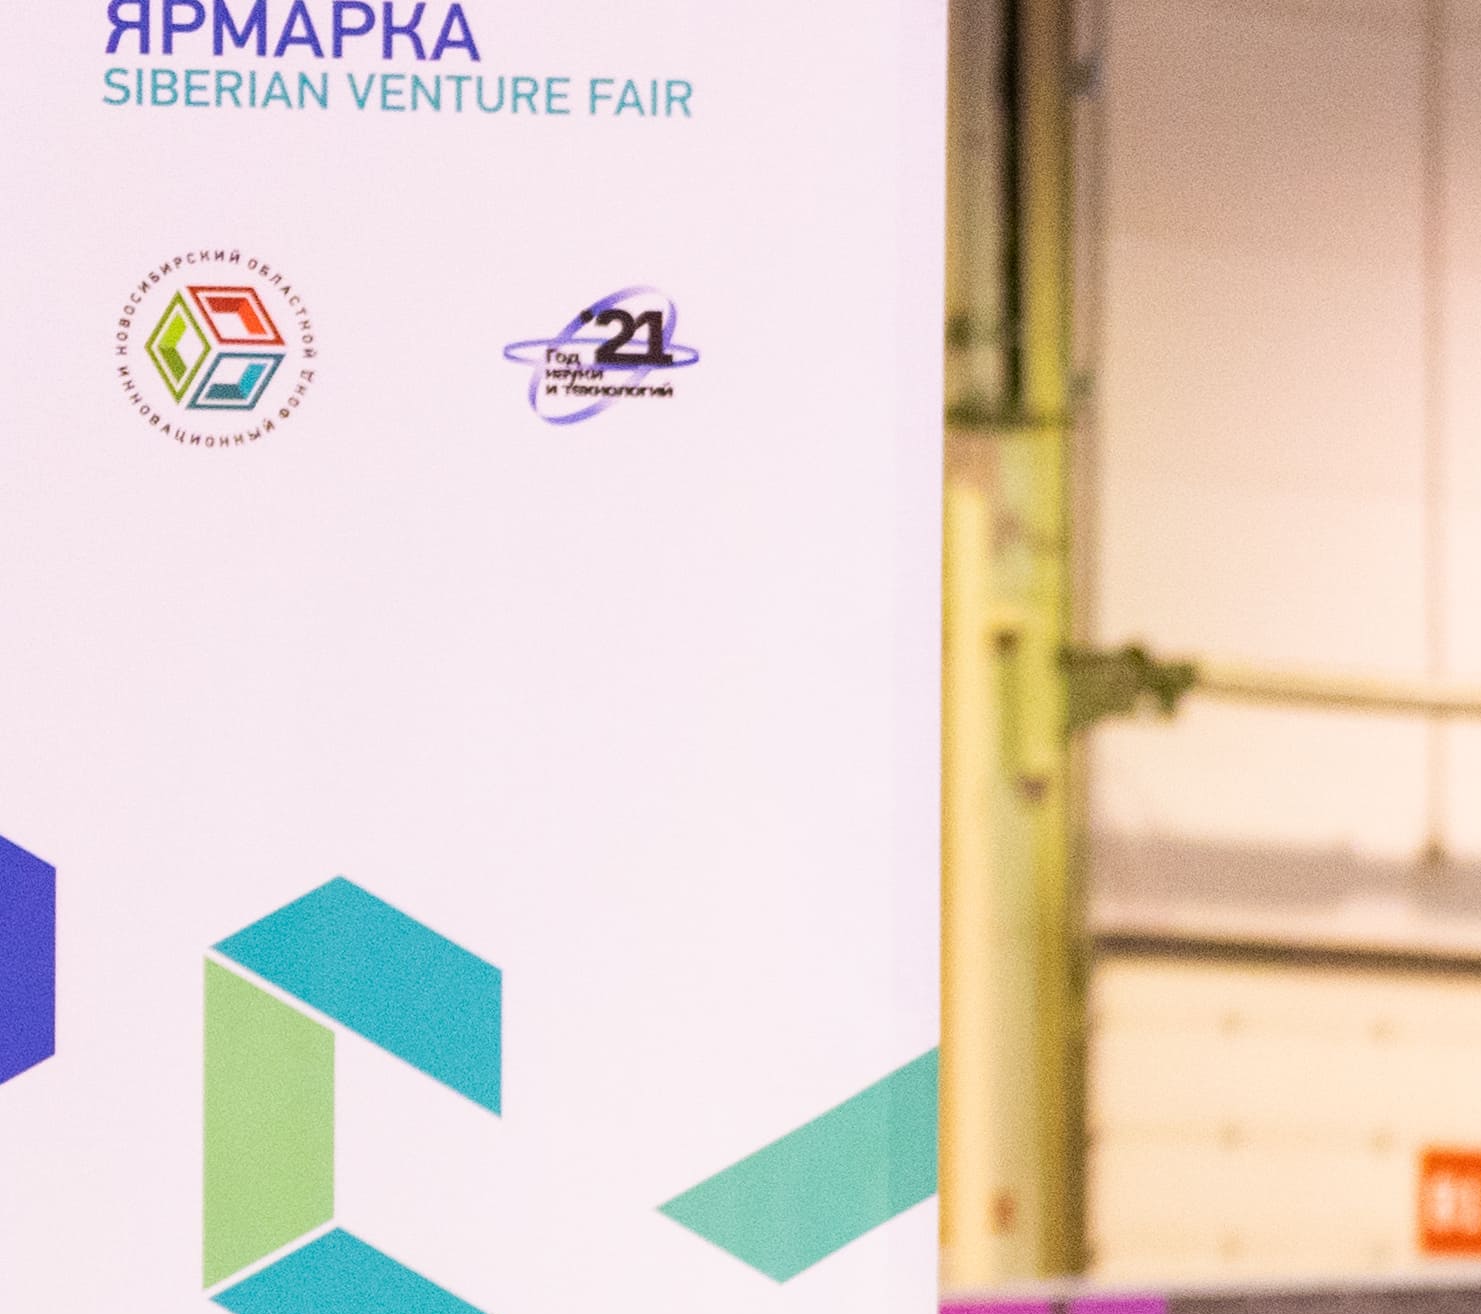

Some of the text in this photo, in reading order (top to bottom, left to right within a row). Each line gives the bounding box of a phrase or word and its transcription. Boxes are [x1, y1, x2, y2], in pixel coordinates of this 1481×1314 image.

[105, 0, 481, 62] ЯРМАРКА
[102, 67, 694, 119] SIBERIAN VENTURE FAIR
[116, 250, 317, 359] НОВОСИБИРСКИЙ ОБЛАСТНОЙ
[546, 348, 581, 366] Год
[117, 366, 316, 449] ИННОВАЦИОННЫЙ ФОНД
